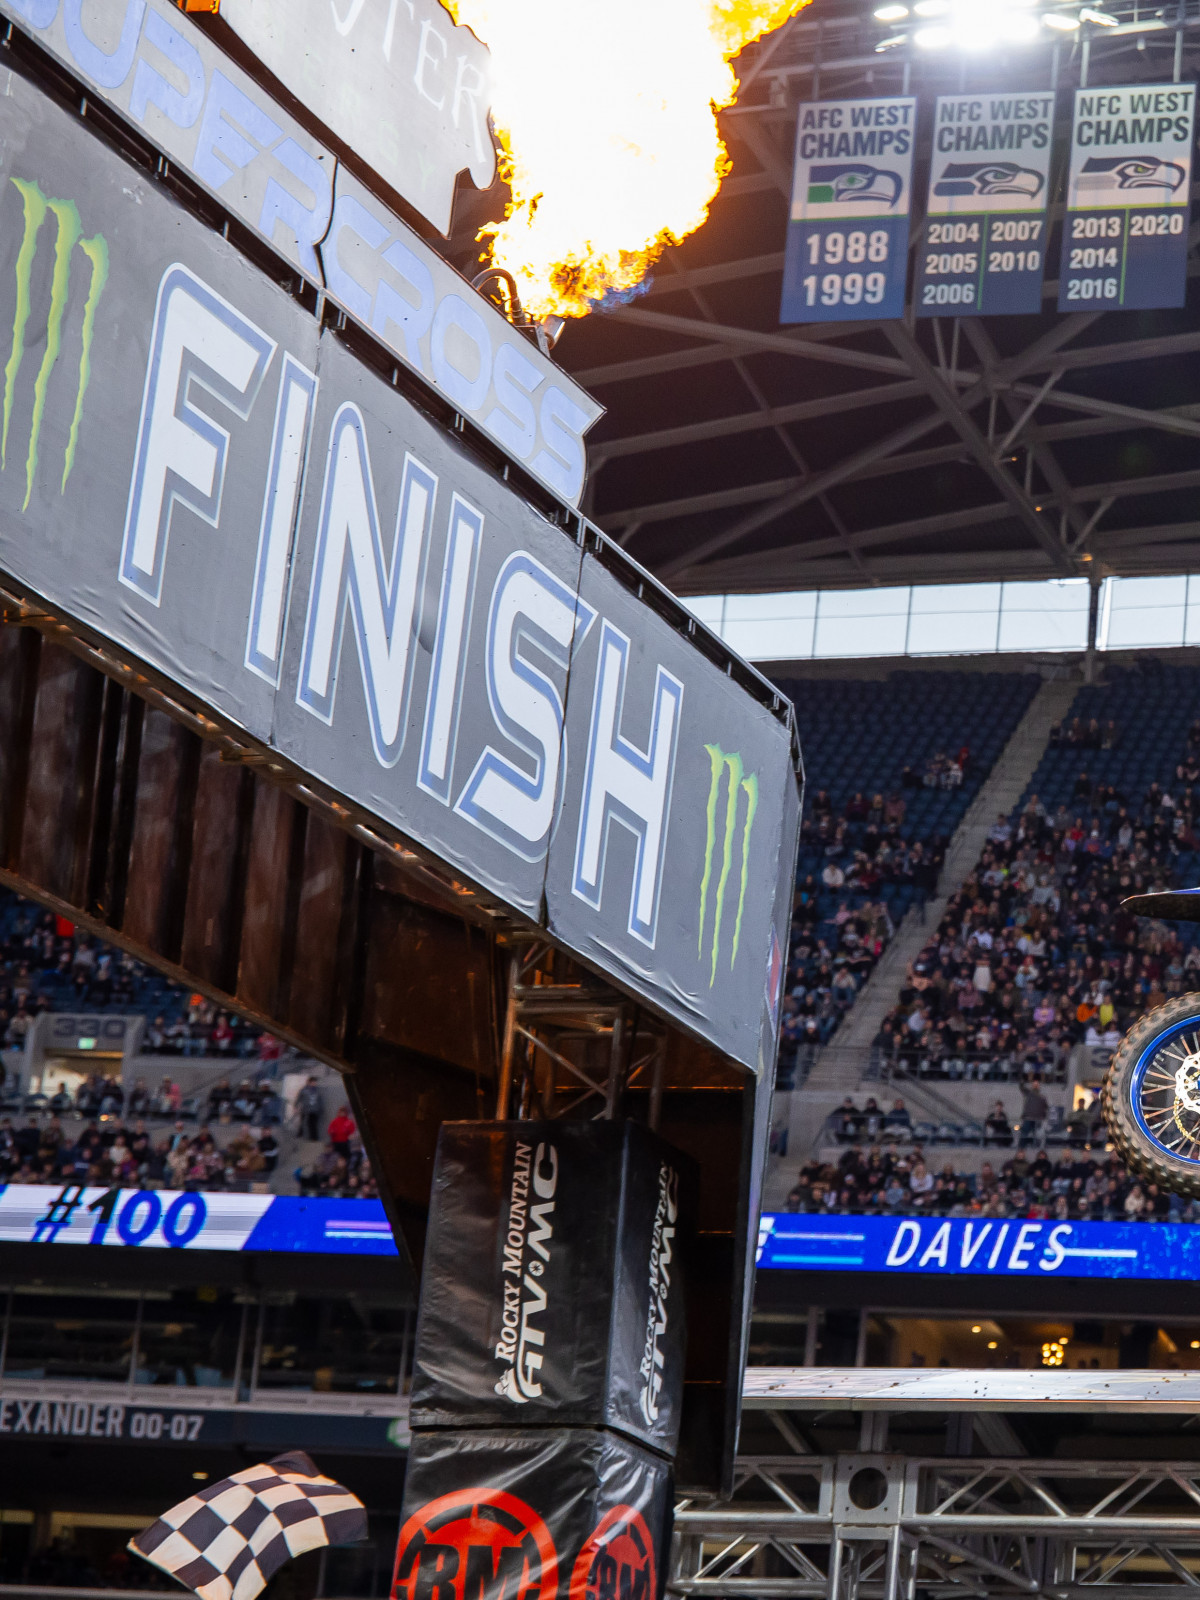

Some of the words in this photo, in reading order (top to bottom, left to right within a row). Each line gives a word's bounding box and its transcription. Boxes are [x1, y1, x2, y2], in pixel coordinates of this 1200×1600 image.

[802, 108, 842, 129] AFC
[850, 105, 912, 127] WEST
[940, 100, 981, 122] NFC
[989, 99, 1053, 120] WEST
[1079, 96, 1121, 117] NFC
[1130, 91, 1193, 113] WEST
[800, 129, 910, 159] CHAMPS
[937, 123, 1048, 152] CHAMPS
[1076, 117, 1189, 146] CHAMPS
[928, 223, 980, 243] 2004
[991, 221, 1043, 241] 2007
[1072, 217, 1121, 238] 2013
[1130, 214, 1183, 236] 2020
[5, 0, 589, 499] UPERCROSS
[806, 231, 889, 265] 1988
[925, 253, 977, 274] 2005
[988, 251, 1040, 272] 2010
[1069, 248, 1117, 269] 2014
[803, 272, 886, 306] 1999
[922, 284, 975, 304] 2006
[1067, 279, 1117, 299] 2016
[119, 262, 684, 949] FINISH
[54, 1018, 126, 1037] 330
[31, 1186, 208, 1246] #100
[502, 1141, 532, 1278] MOUNTAIN
[886, 1221, 1073, 1271] DAVIES
[495, 1280, 521, 1364] ROCKY
[130, 1412, 204, 1441] 00-07
